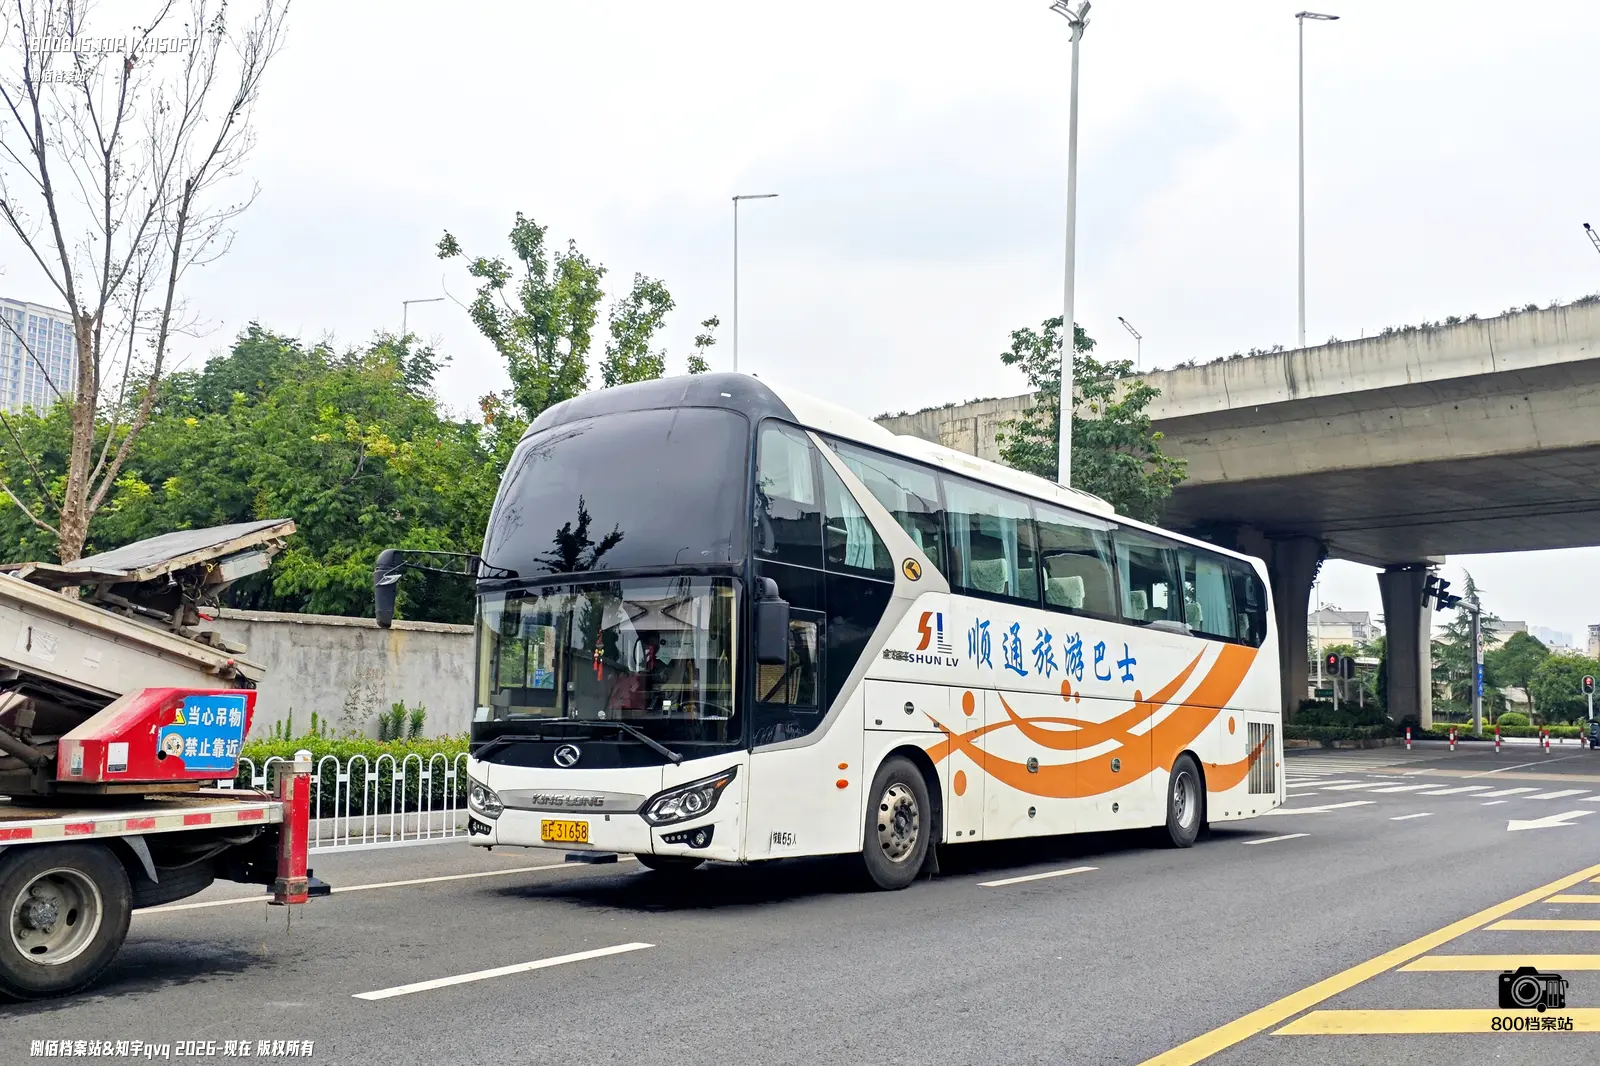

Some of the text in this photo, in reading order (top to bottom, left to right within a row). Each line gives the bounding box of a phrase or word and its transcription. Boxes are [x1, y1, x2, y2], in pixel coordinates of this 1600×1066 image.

[909, 653, 959, 668] SHUN LV
[967, 617, 1137, 683] 顺通旅游巴士
[188, 705, 242, 728] 当心吊物
[184, 736, 239, 758] 禁止靠近
[532, 793, 605, 807] KING LONG
